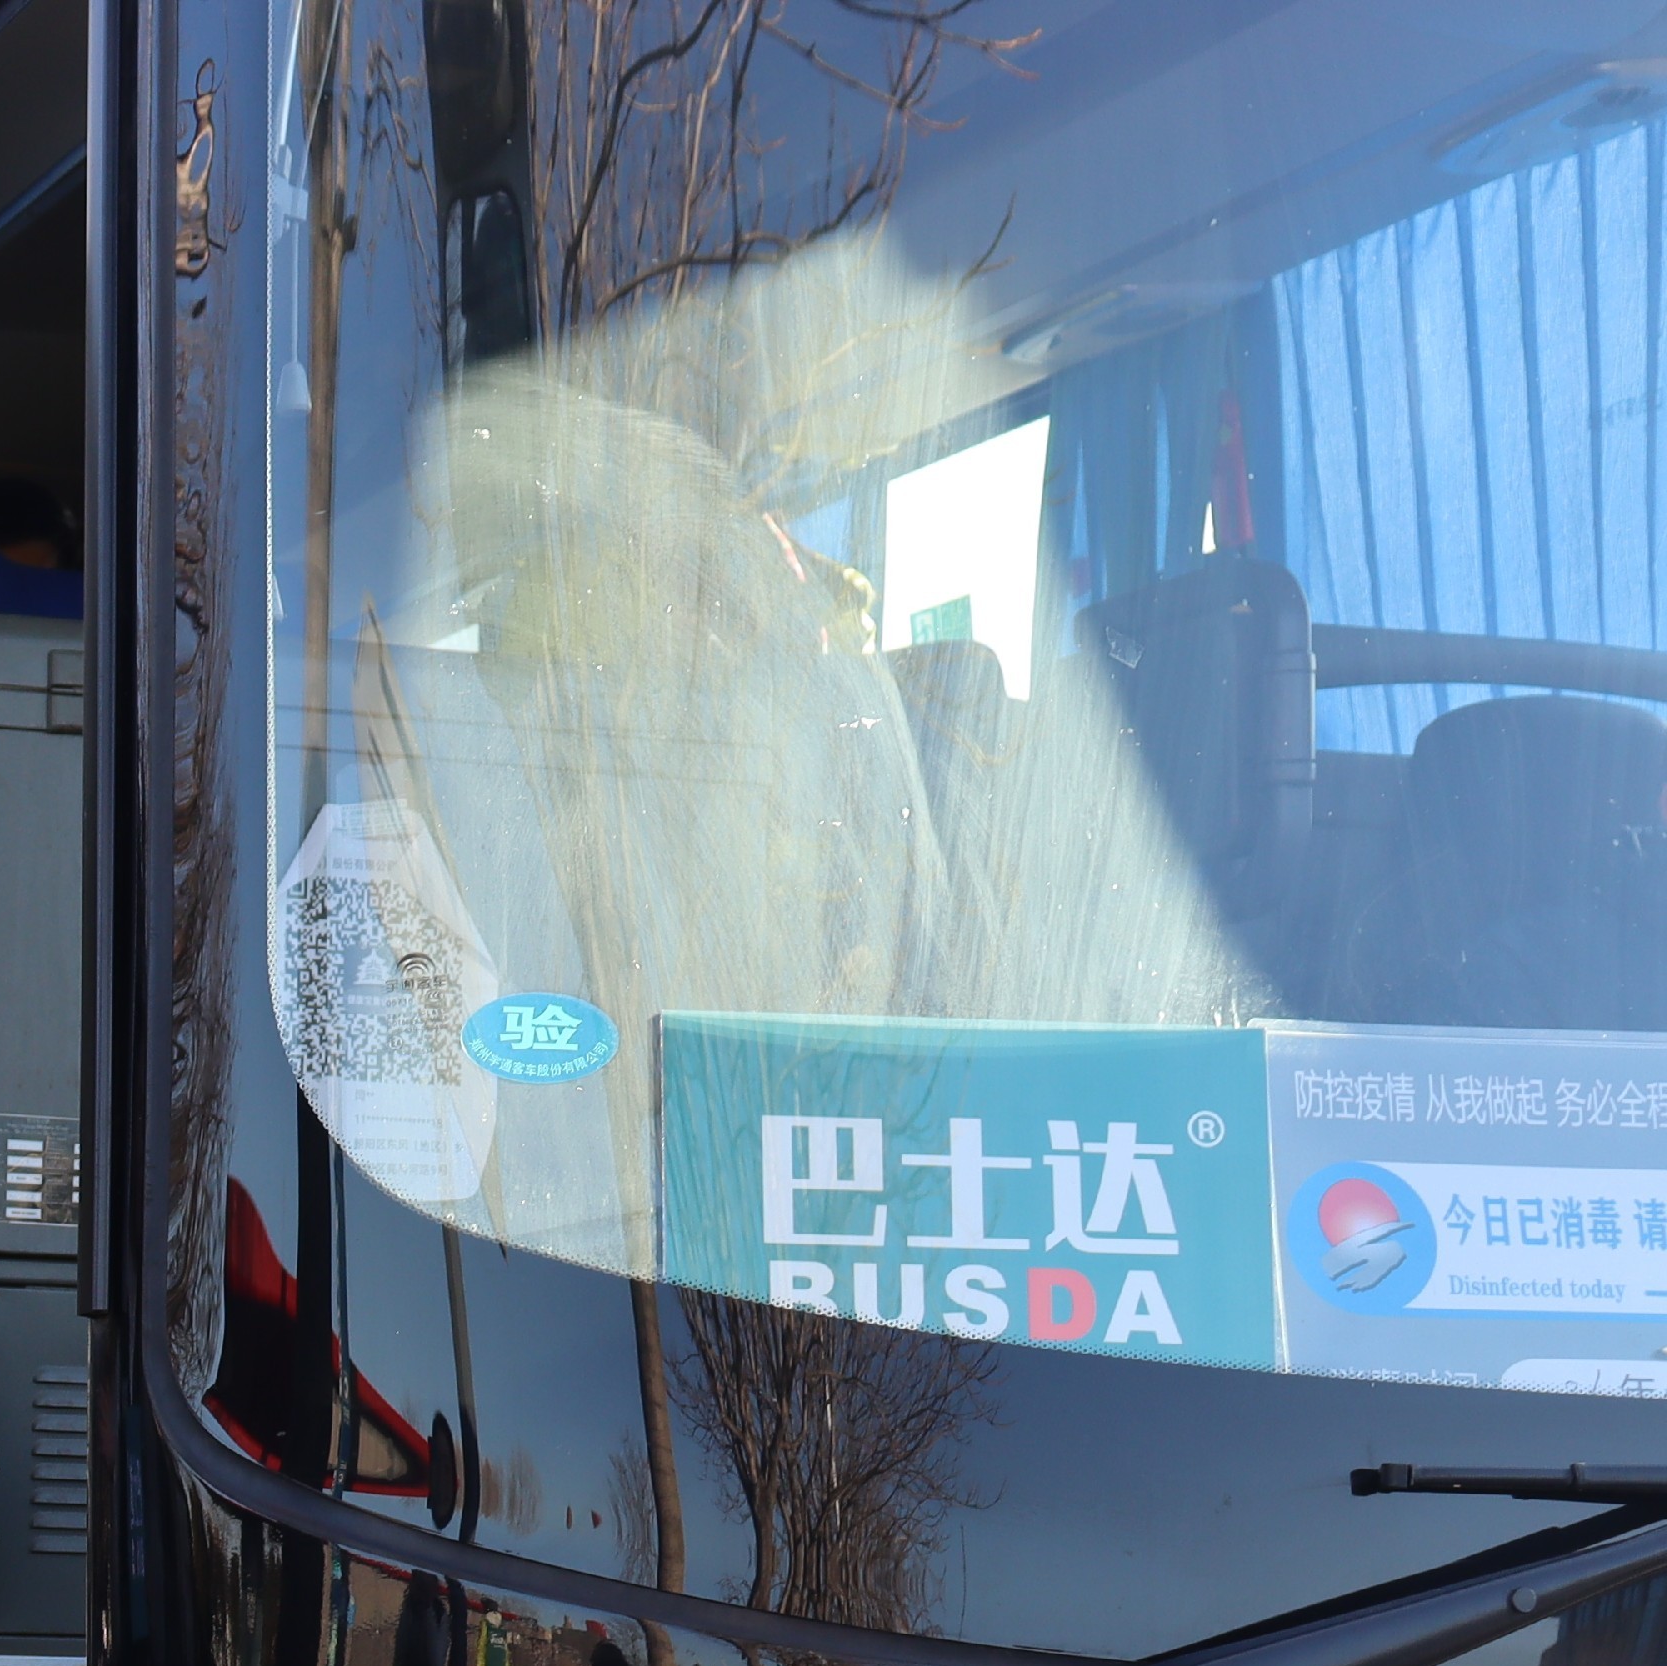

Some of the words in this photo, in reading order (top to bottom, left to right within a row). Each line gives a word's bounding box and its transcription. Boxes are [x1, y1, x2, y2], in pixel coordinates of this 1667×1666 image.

[500, 1003, 583, 1051] 验
[468, 1038, 610, 1078] 郑州宇通客车股份有限公司
[1294, 1069, 1416, 1123] 防控疫情
[1425, 1073, 1548, 1126] 从我做起
[761, 1114, 1180, 1256] 巴士达
[1443, 1193, 1623, 1250] 今日已消毒
[768, 1259, 1183, 1346] BUSDA
[1448, 1273, 1564, 1297] Disinfected
[1570, 1278, 1627, 1304] today
